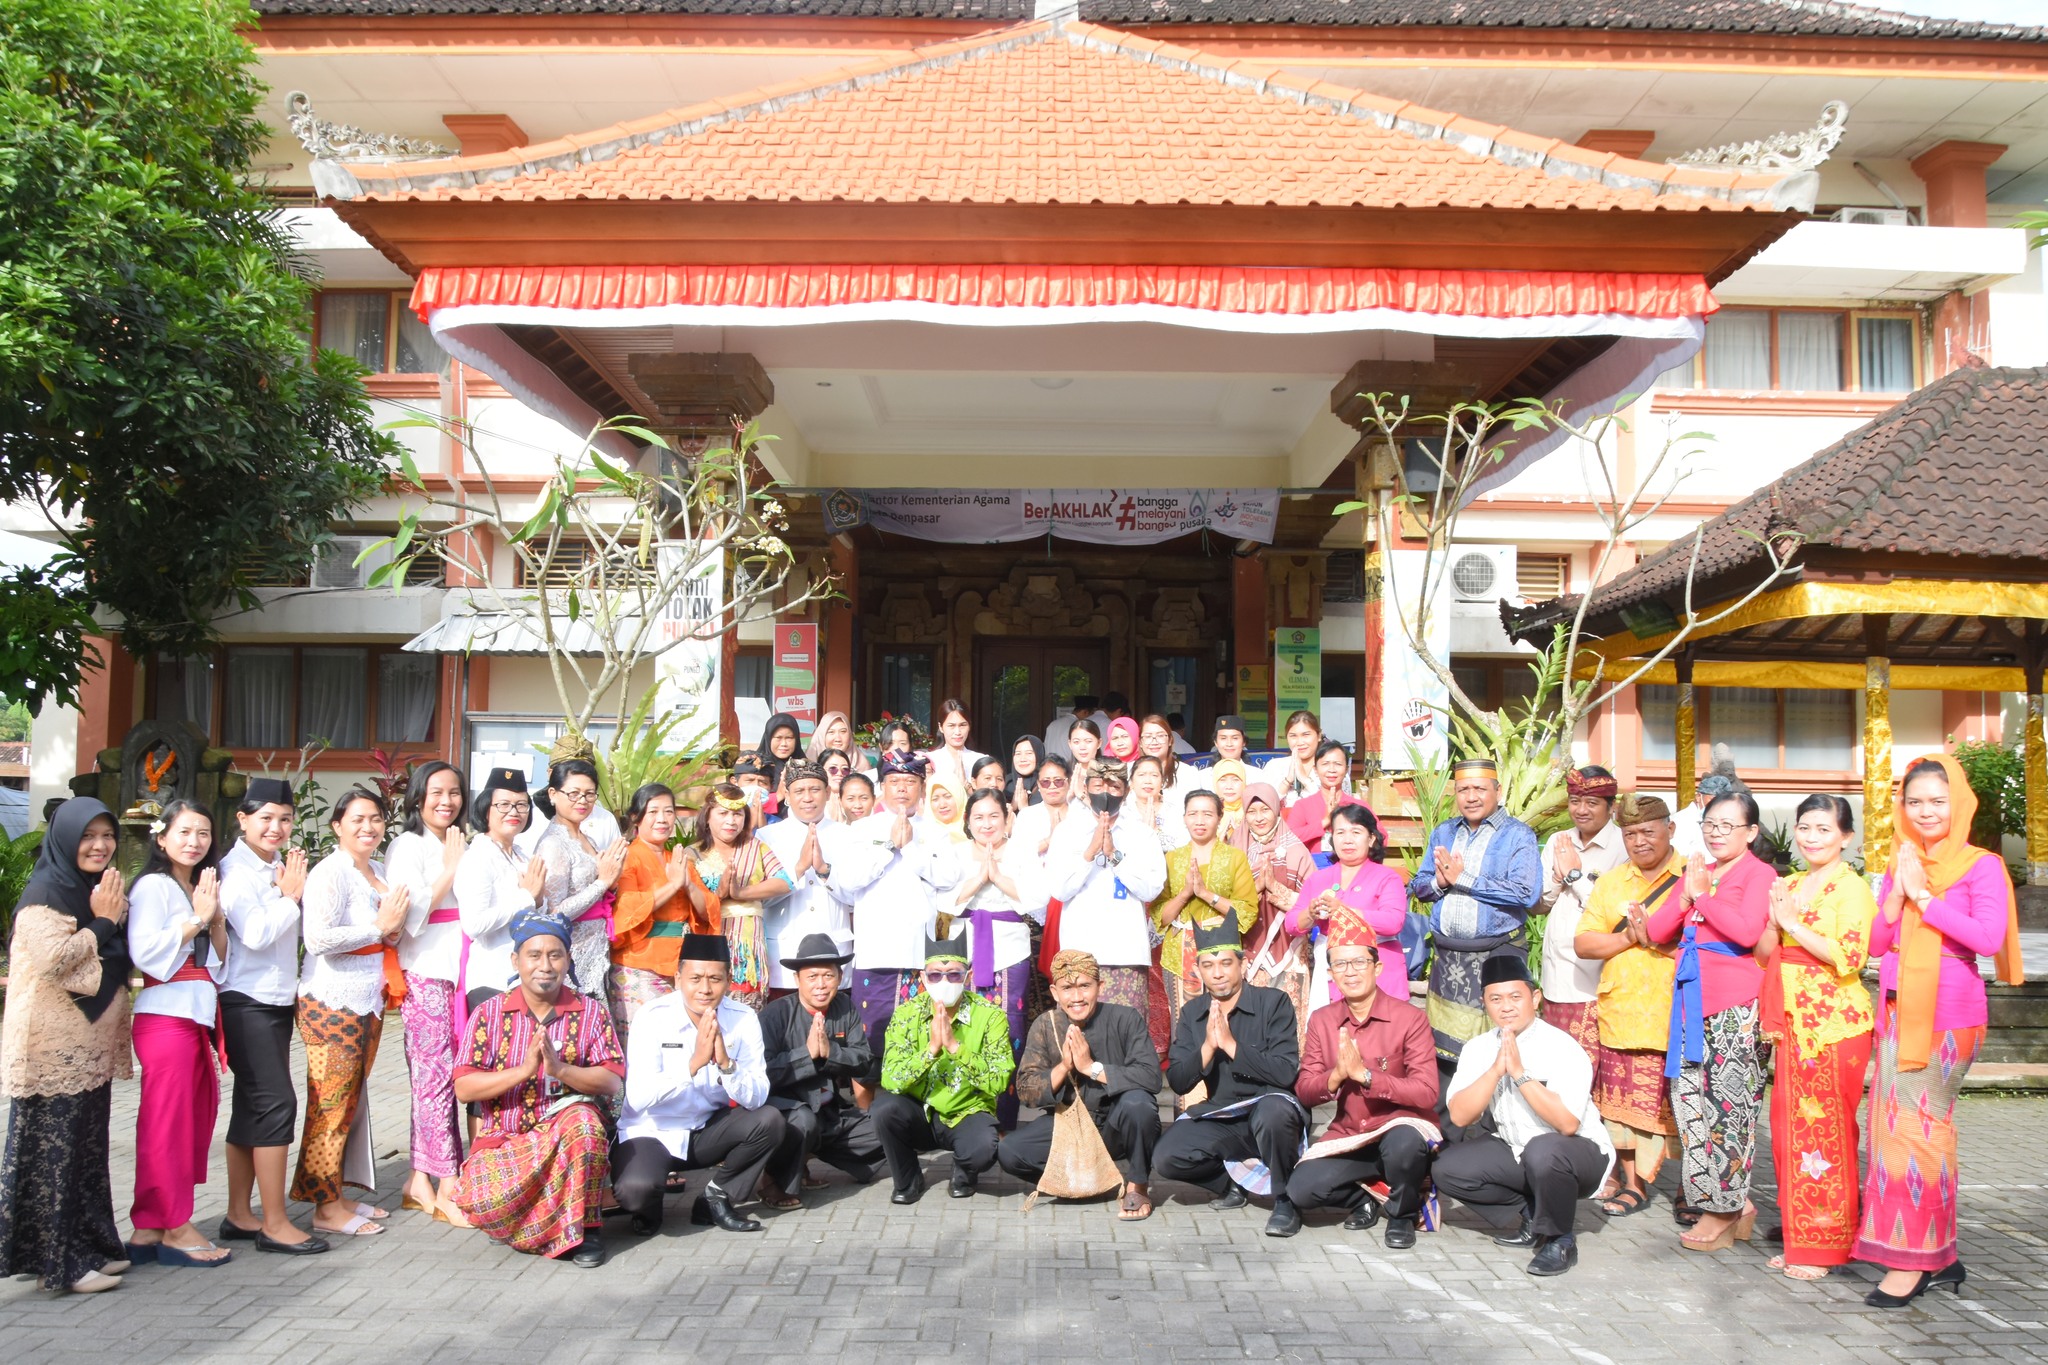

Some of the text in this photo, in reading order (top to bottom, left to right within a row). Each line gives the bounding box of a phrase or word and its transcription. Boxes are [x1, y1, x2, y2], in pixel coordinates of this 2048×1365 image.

[868, 494, 1011, 508] antor Kementerian Agama
[1137, 496, 1178, 509] bangga
[1024, 502, 1113, 518] BerAKHLAK
[1137, 508, 1186, 520] melayani
[664, 597, 714, 619] TOAK
[1293, 655, 1304, 674] 5
[787, 696, 804, 706] wbs
